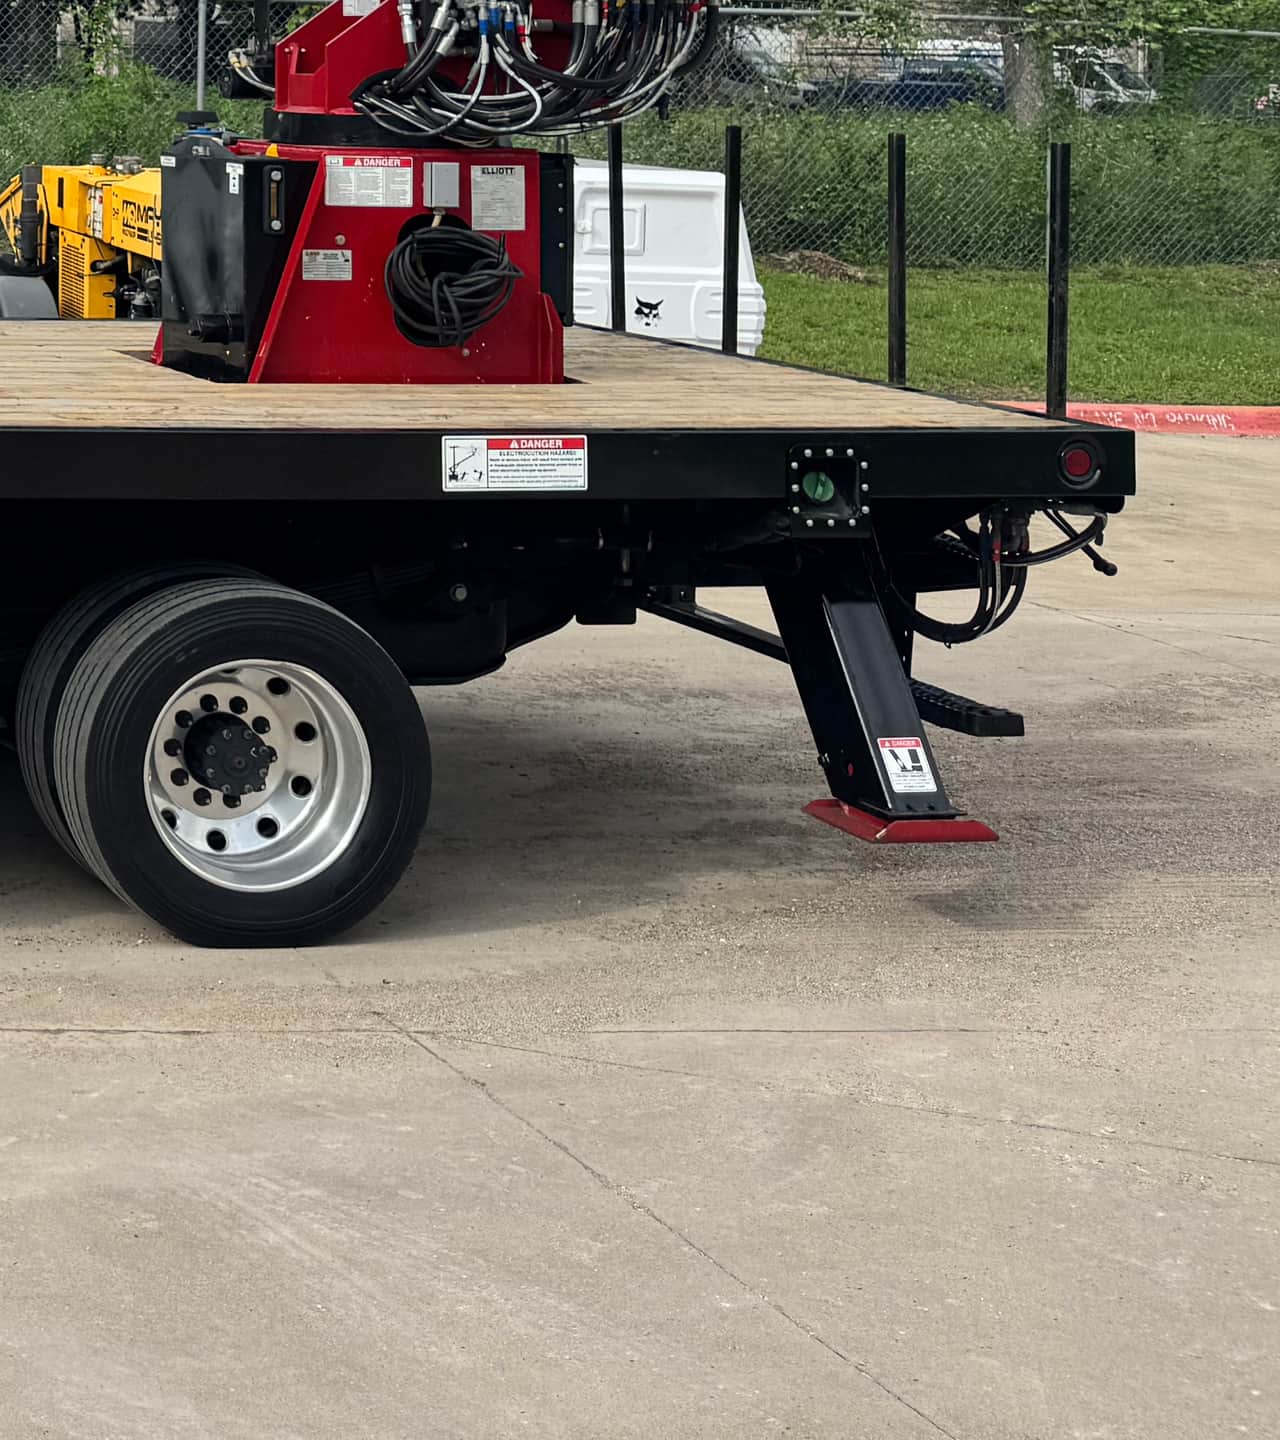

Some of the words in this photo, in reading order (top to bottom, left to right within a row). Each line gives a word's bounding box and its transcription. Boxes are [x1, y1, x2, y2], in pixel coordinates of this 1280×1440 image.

[363, 158, 401, 167] DANGER
[481, 167, 515, 175] ELLIOTT
[521, 440, 563, 449] DANGER
